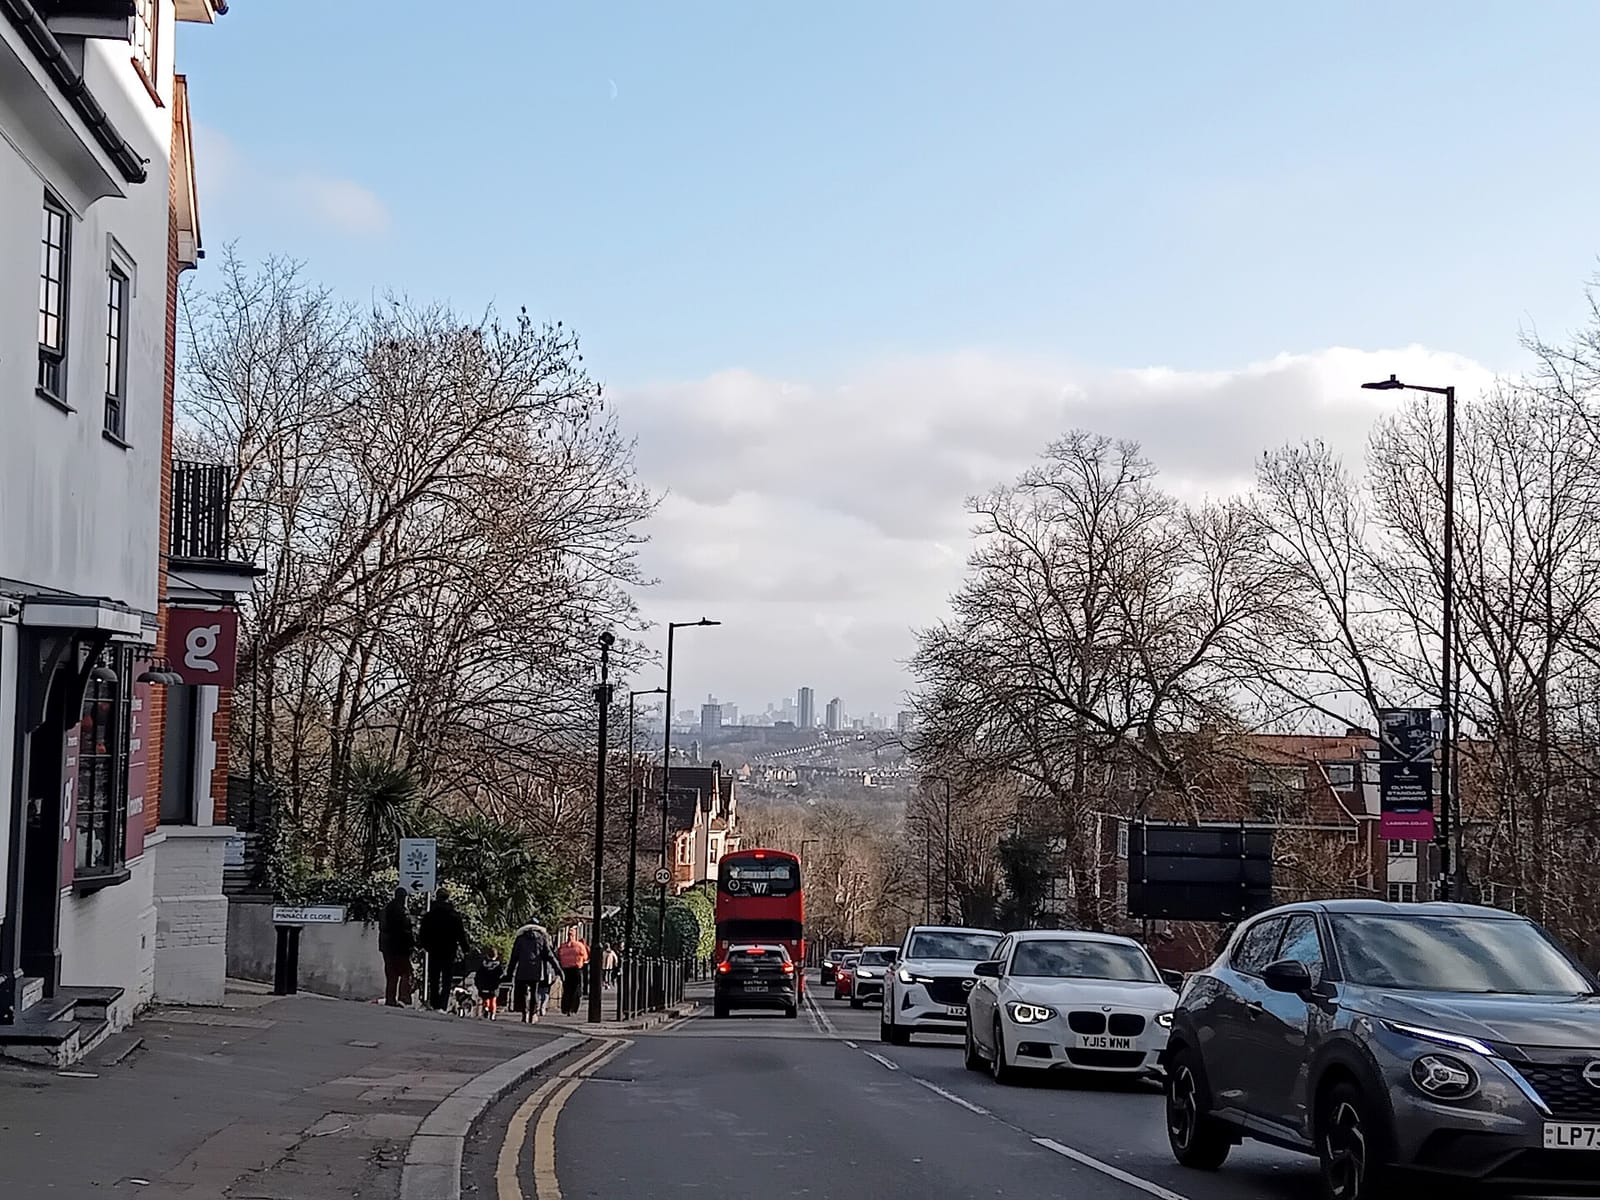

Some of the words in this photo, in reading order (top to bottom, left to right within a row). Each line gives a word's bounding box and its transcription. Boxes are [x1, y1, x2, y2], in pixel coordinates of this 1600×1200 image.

[184, 624, 221, 672] g
[657, 872, 669, 880] 20
[752, 882, 768, 894] W7
[1082, 1035, 1107, 1048] YJ15
[1109, 1037, 1130, 1049] WNM
